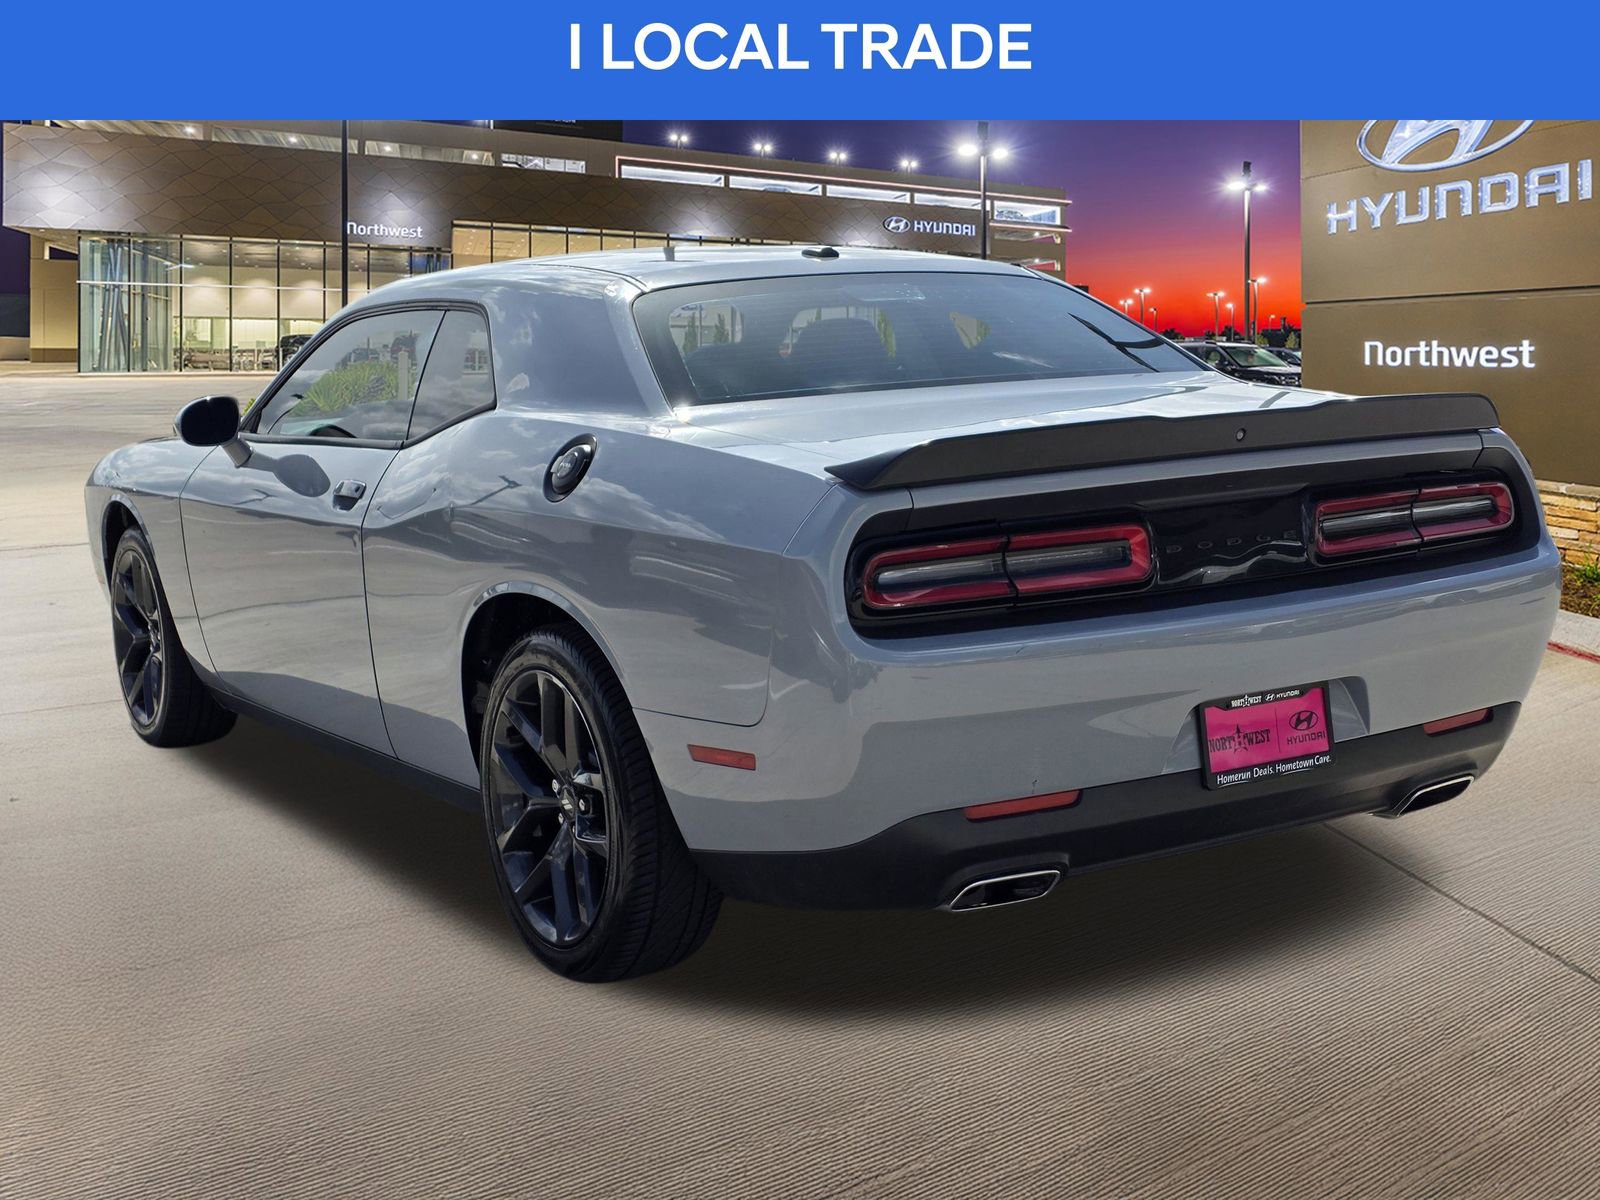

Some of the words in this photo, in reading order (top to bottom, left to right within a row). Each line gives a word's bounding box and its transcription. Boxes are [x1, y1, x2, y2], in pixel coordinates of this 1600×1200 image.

[1326, 158, 1593, 234] HYUNDAI
[346, 221, 423, 238] Northwest
[913, 220, 976, 236] HYUNDAI
[1363, 339, 1536, 368] Northwest
[1166, 529, 1297, 554] DODGE
[1286, 731, 1327, 745] HYUNDAI
[1216, 767, 1251, 785] Homerun
[1253, 764, 1274, 778] Deals.
[1275, 758, 1314, 773] Hometown
[1314, 754, 1332, 765] Care.
